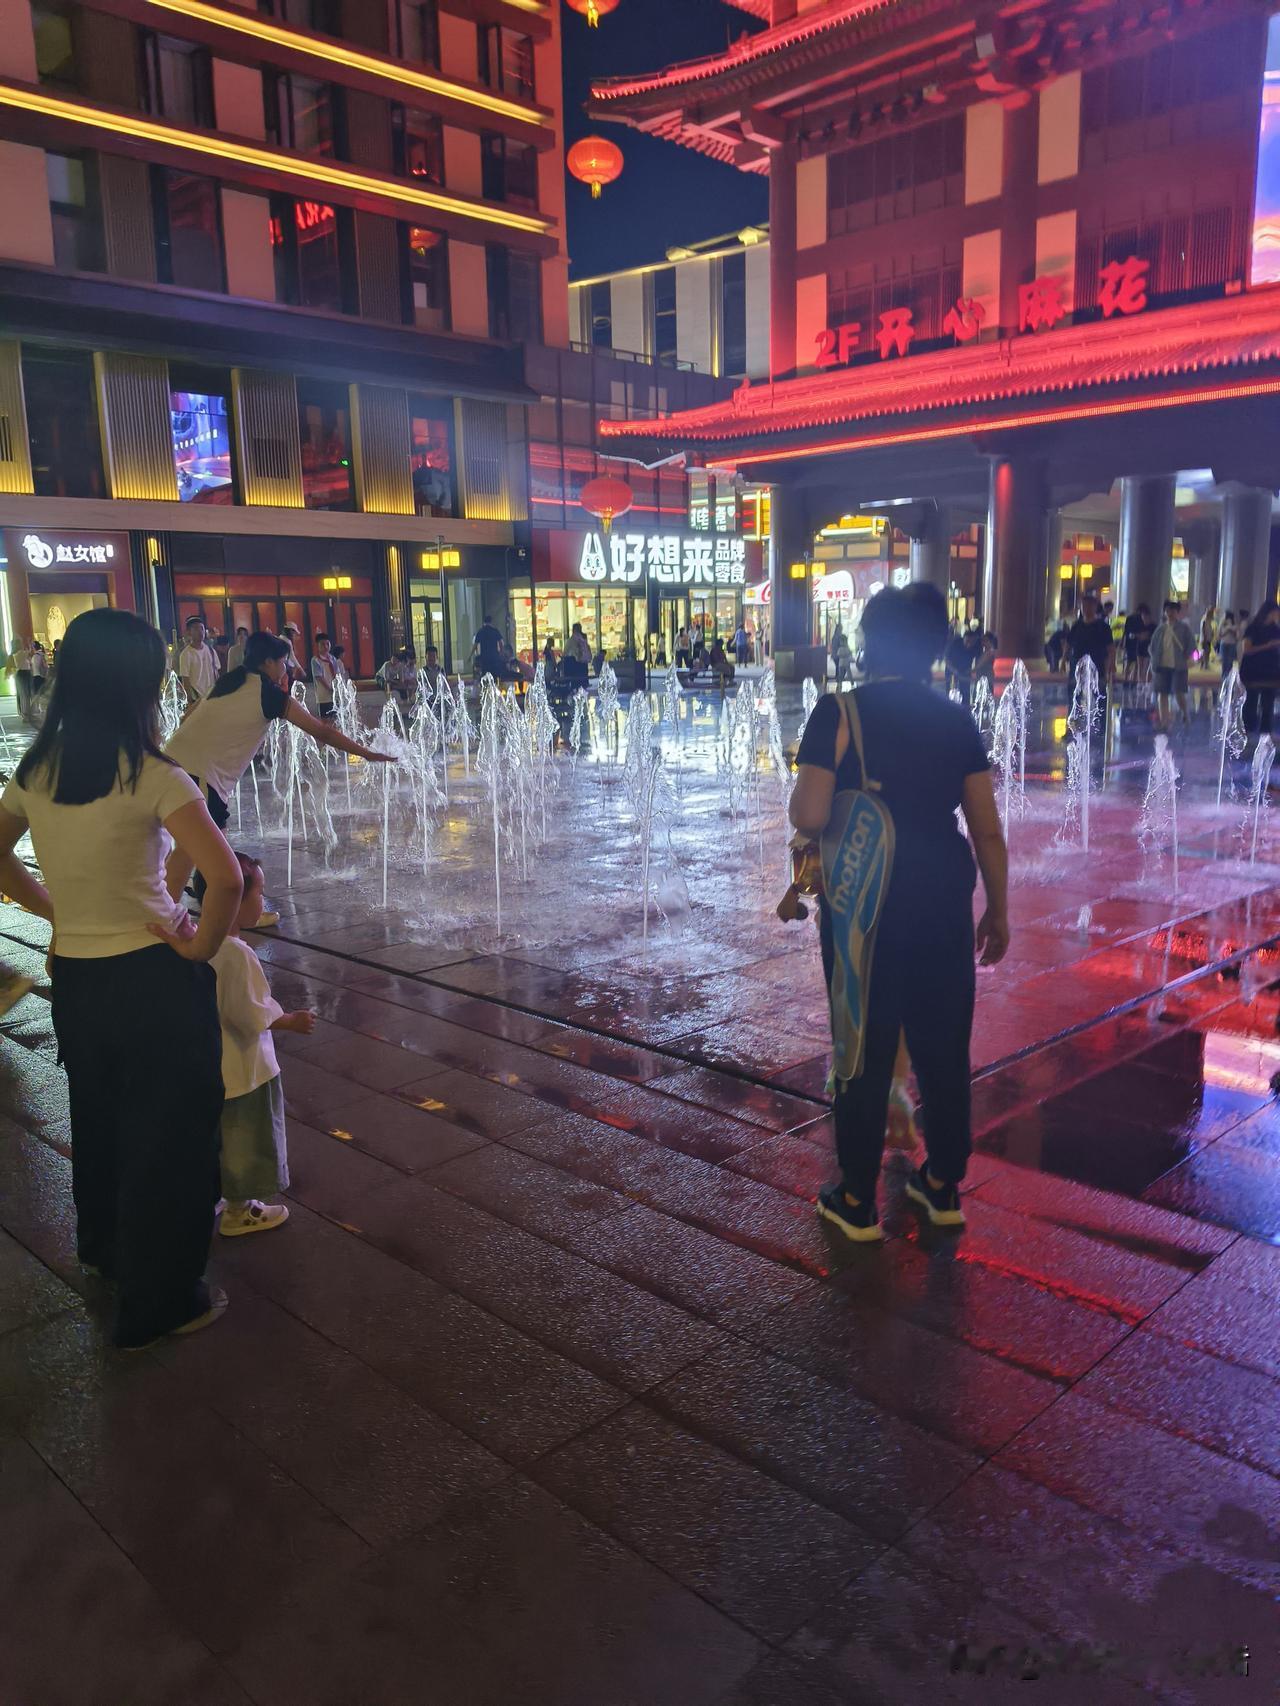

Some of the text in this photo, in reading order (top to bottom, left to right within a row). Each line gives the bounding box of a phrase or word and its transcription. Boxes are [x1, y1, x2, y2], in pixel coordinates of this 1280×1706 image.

[815, 256, 1149, 367] 2F 开心麻花
[610, 535, 714, 583] 好想来
[715, 539, 746, 562] 品牌
[715, 562, 746, 584] 零食
[832, 810, 877, 914] motion
